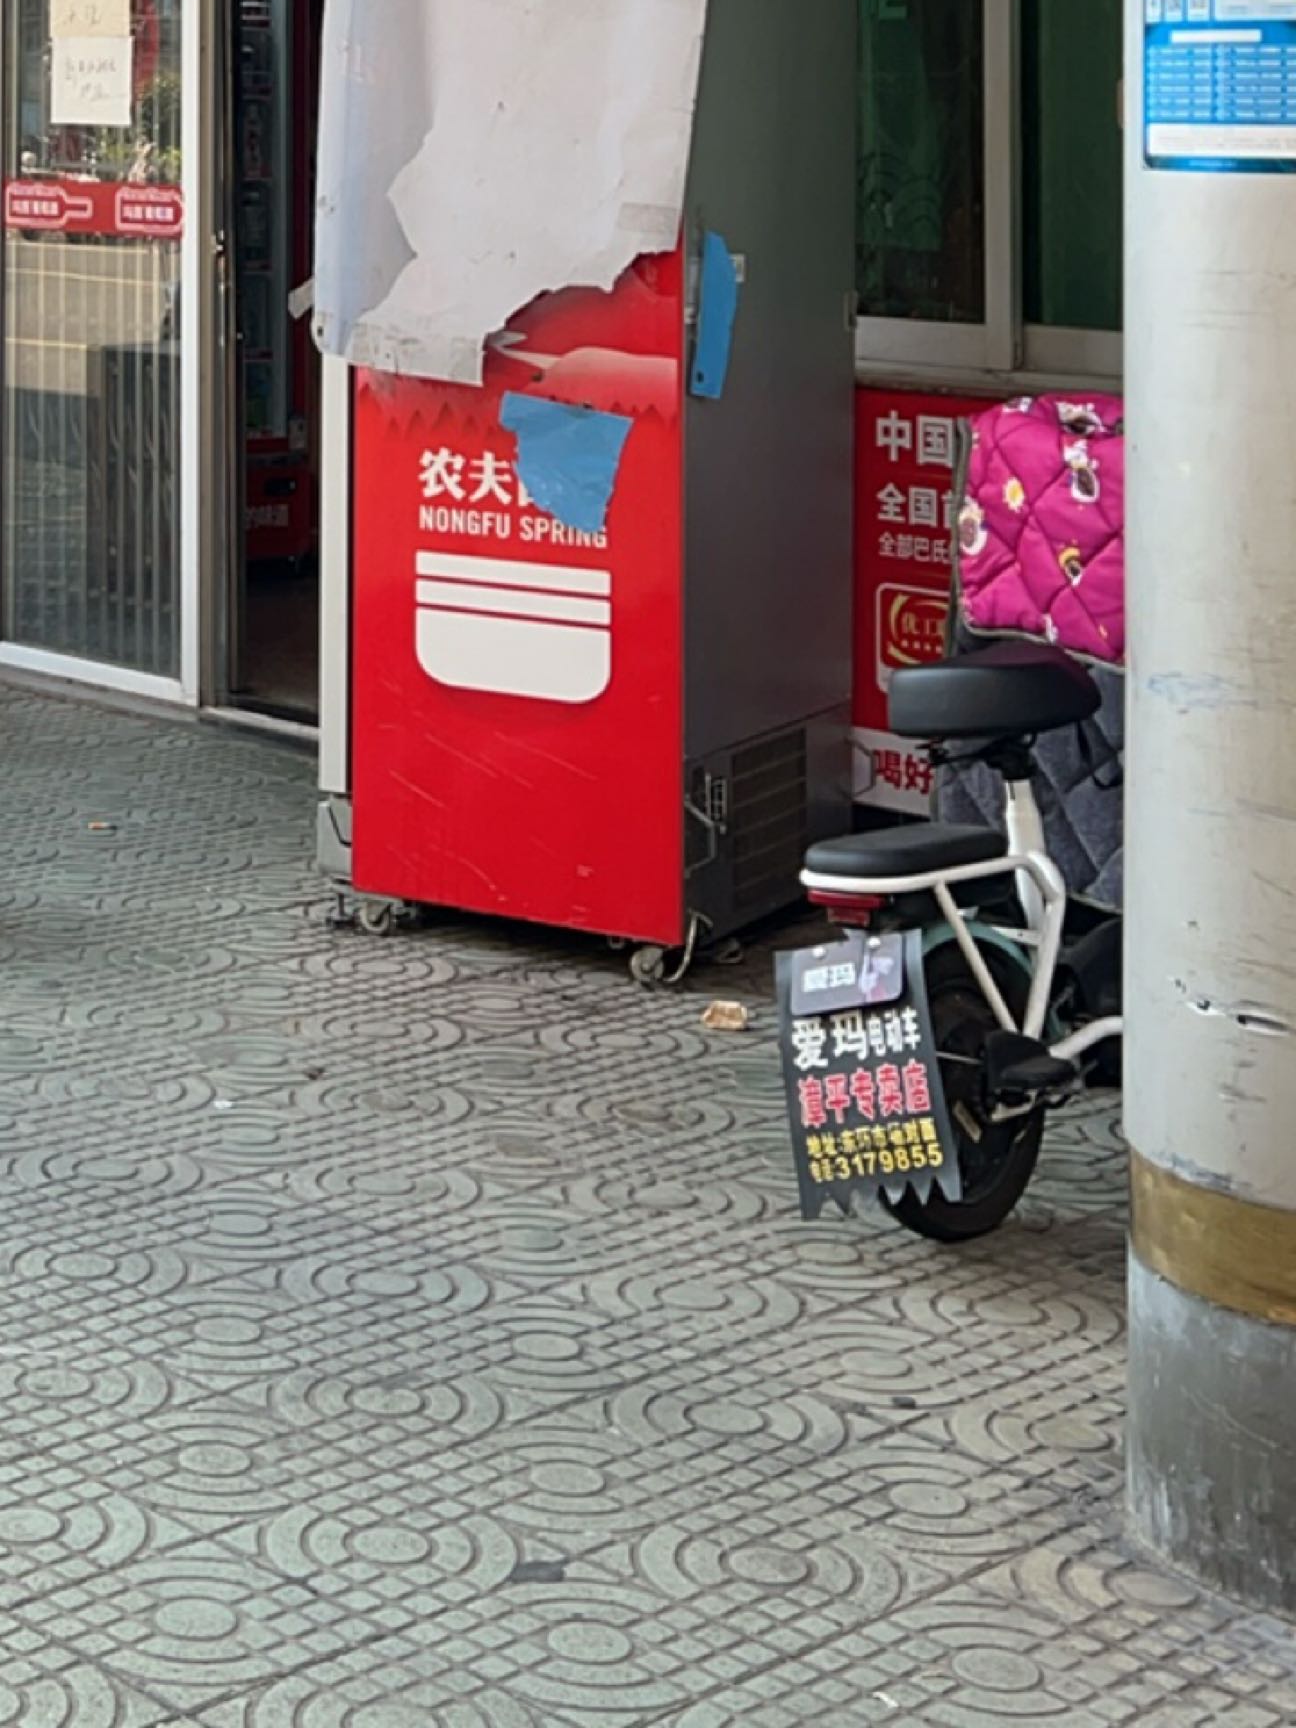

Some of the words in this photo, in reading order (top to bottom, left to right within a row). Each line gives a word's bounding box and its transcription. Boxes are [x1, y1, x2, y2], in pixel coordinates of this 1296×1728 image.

[418, 446, 535, 508] 农夫
[419, 504, 512, 540] NONGFU
[873, 749, 935, 795] 喝好
